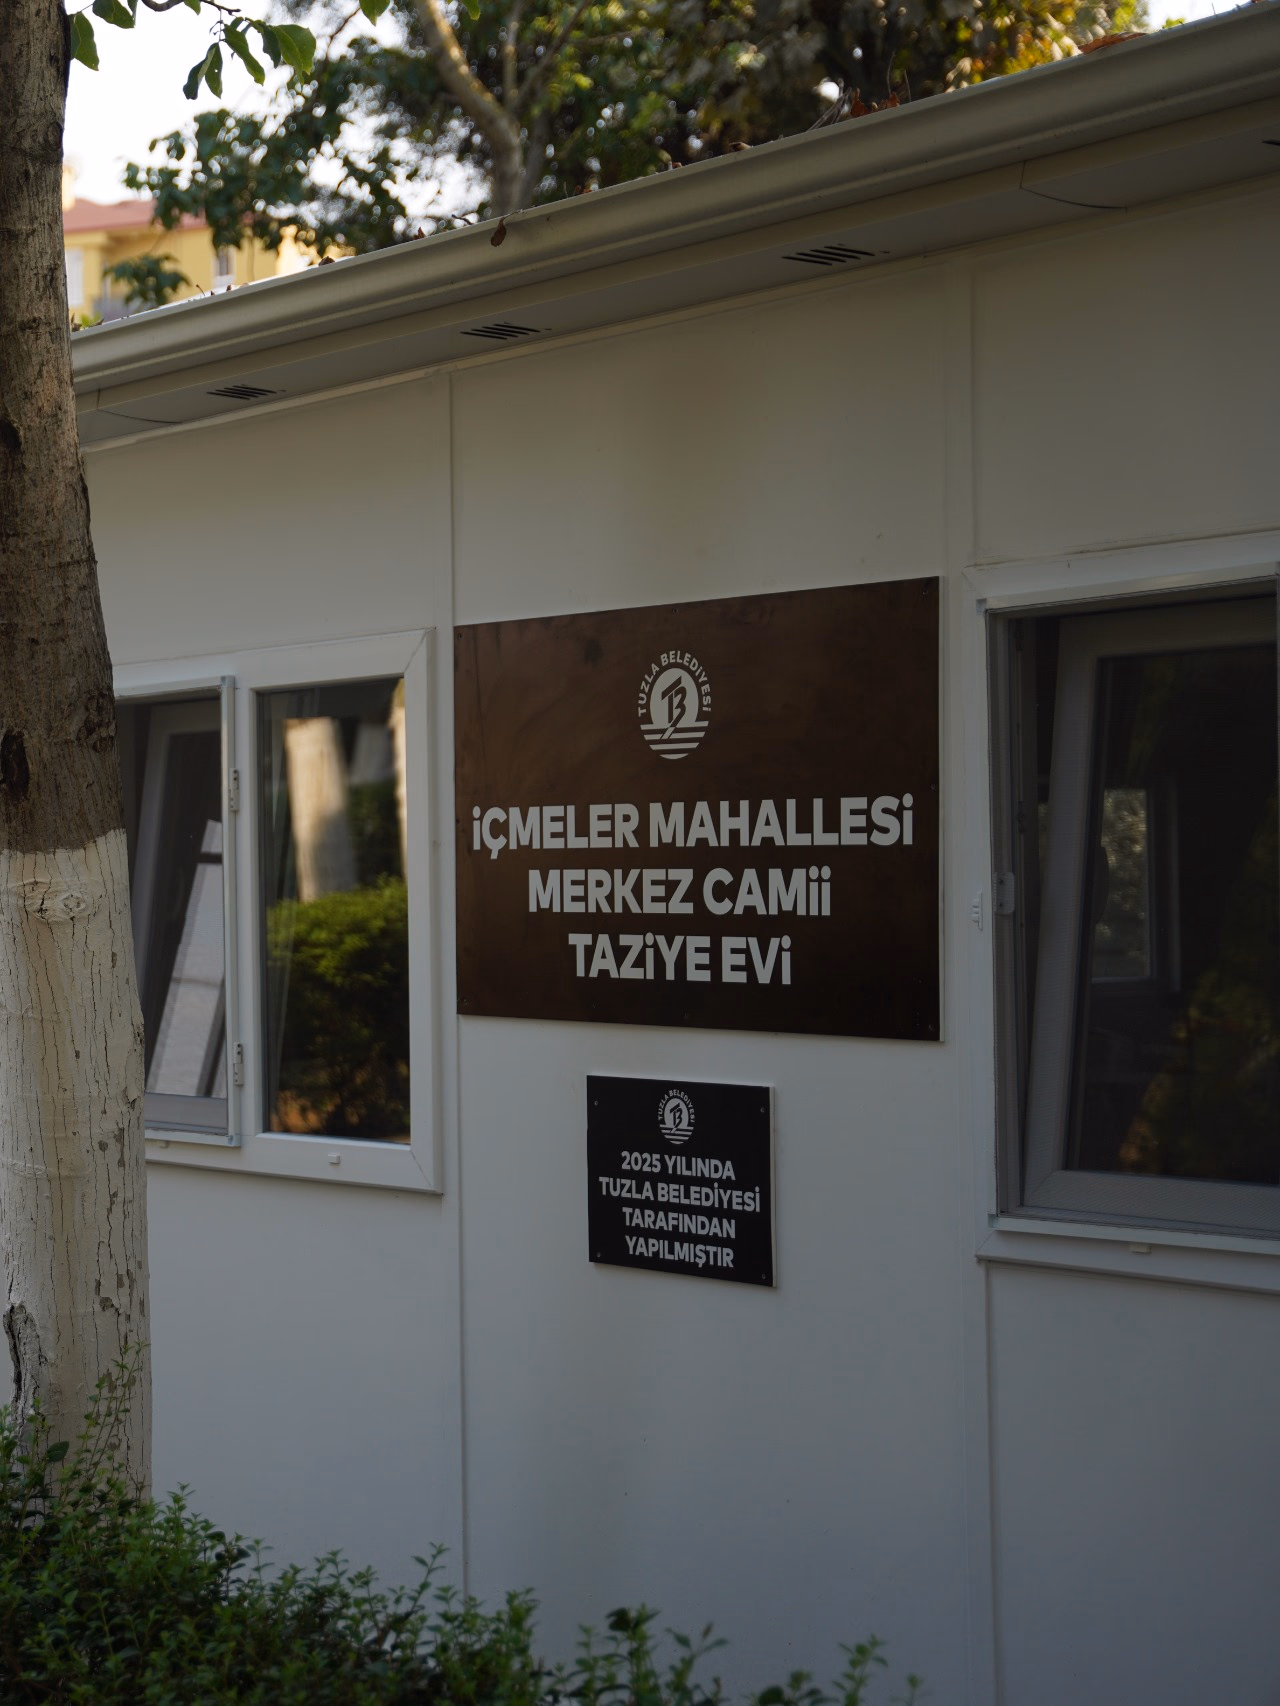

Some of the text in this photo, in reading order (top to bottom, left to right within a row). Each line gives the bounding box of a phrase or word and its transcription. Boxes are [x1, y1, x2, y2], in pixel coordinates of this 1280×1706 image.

[637, 663, 660, 717] TUZLA
[528, 868, 694, 914] MERKEZ
[621, 1150, 736, 1181] 2025 YILINDA
[598, 1176, 761, 1213] TUZLA BELEDİYESİ
[622, 1206, 736, 1239] TARAFINDAN
[624, 1235, 734, 1268] YAPILMIŞTIR
